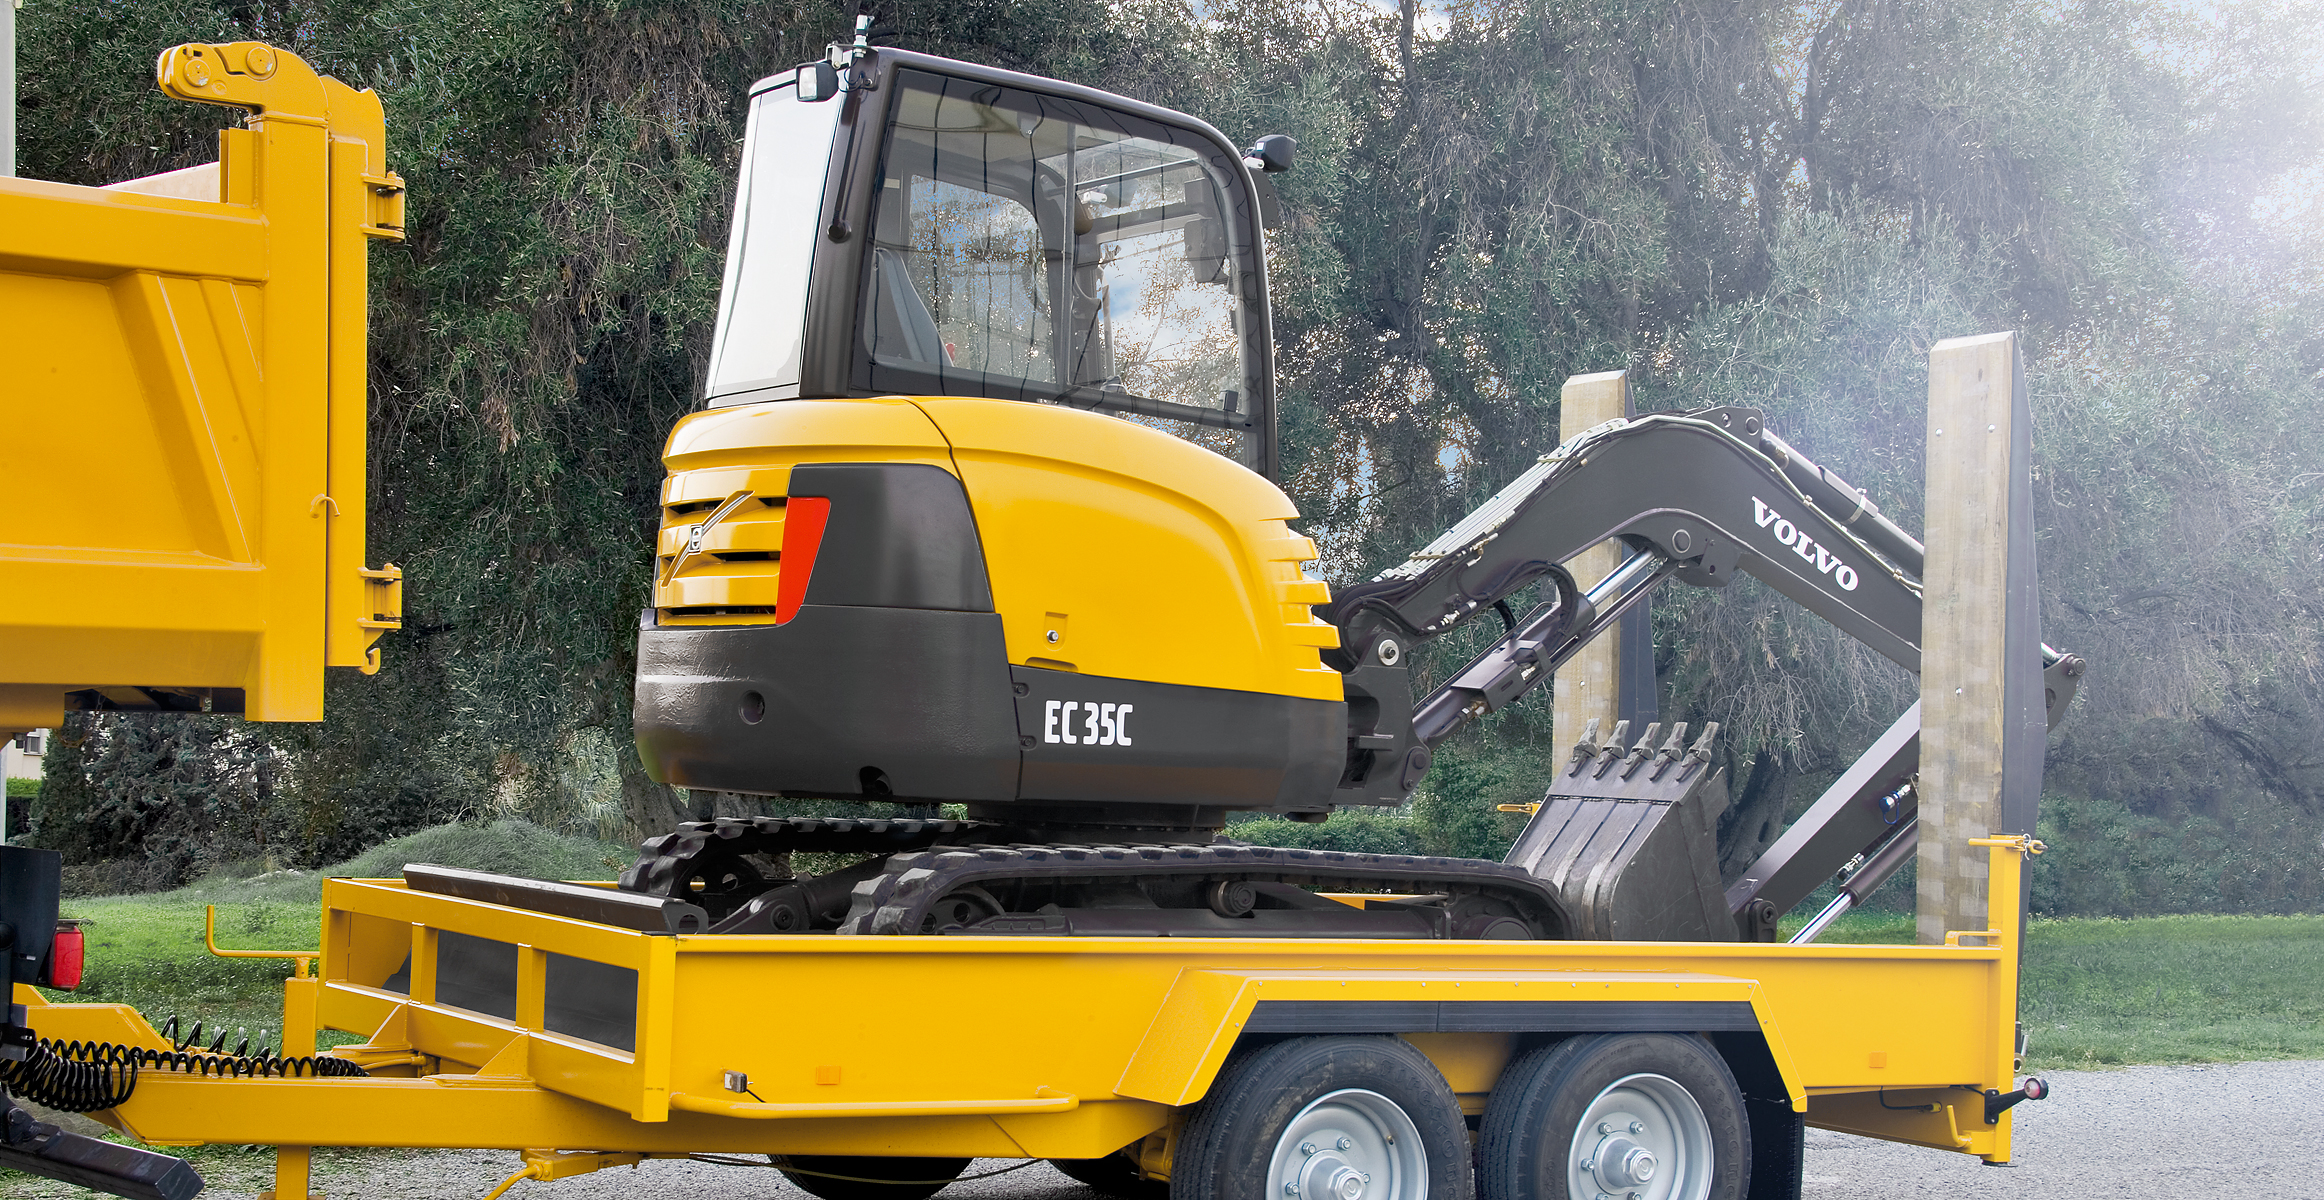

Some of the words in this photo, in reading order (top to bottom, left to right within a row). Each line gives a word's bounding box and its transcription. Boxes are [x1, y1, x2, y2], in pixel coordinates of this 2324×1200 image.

[1752, 496, 1859, 591] VOLVO
[1044, 700, 1079, 744] EC
[1083, 702, 1134, 747] 35C
